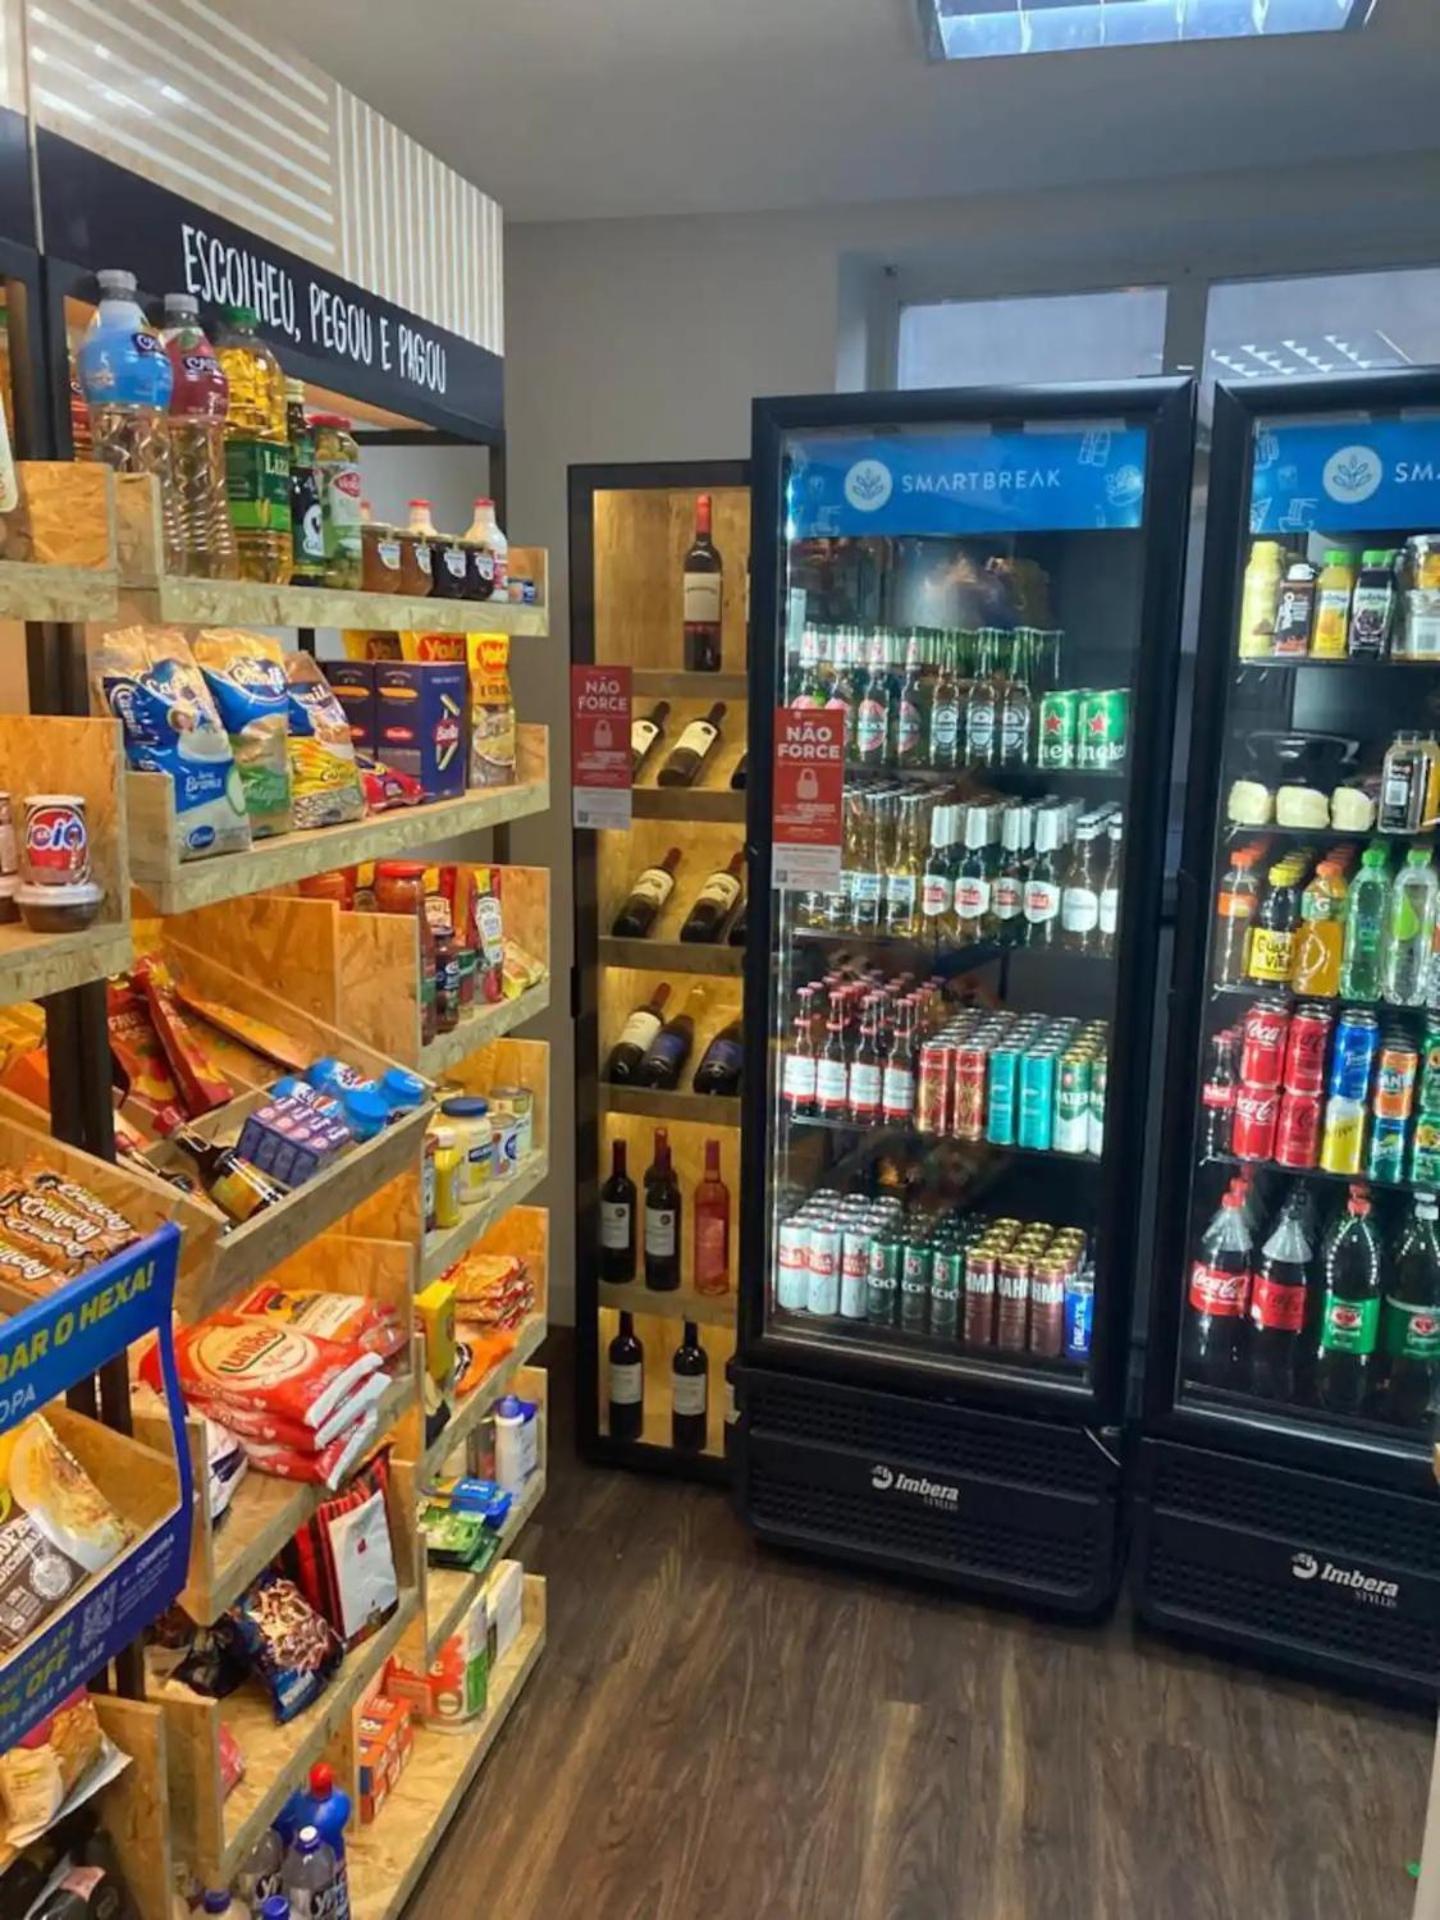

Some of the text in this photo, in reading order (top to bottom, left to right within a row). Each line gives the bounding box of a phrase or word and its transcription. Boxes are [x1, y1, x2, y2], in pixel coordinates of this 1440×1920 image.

[310, 281, 372, 366] PEGOU
[380, 316, 391, 371] E
[398, 324, 446, 394] PAGOU
[902, 469, 1061, 494] SMARTBREAK
[585, 676, 620, 694] NÃO
[578, 697, 627, 711] FORCE
[786, 722, 832, 742] NÃO
[777, 743, 840, 760] FORCE
[20, 1196, 101, 1243] Crunchy
[54, 1312, 74, 1347] O
[79, 1262, 155, 1331] HEXA!
[894, 1472, 959, 1501] Imbera
[1320, 1562, 1399, 1597] Imbera
